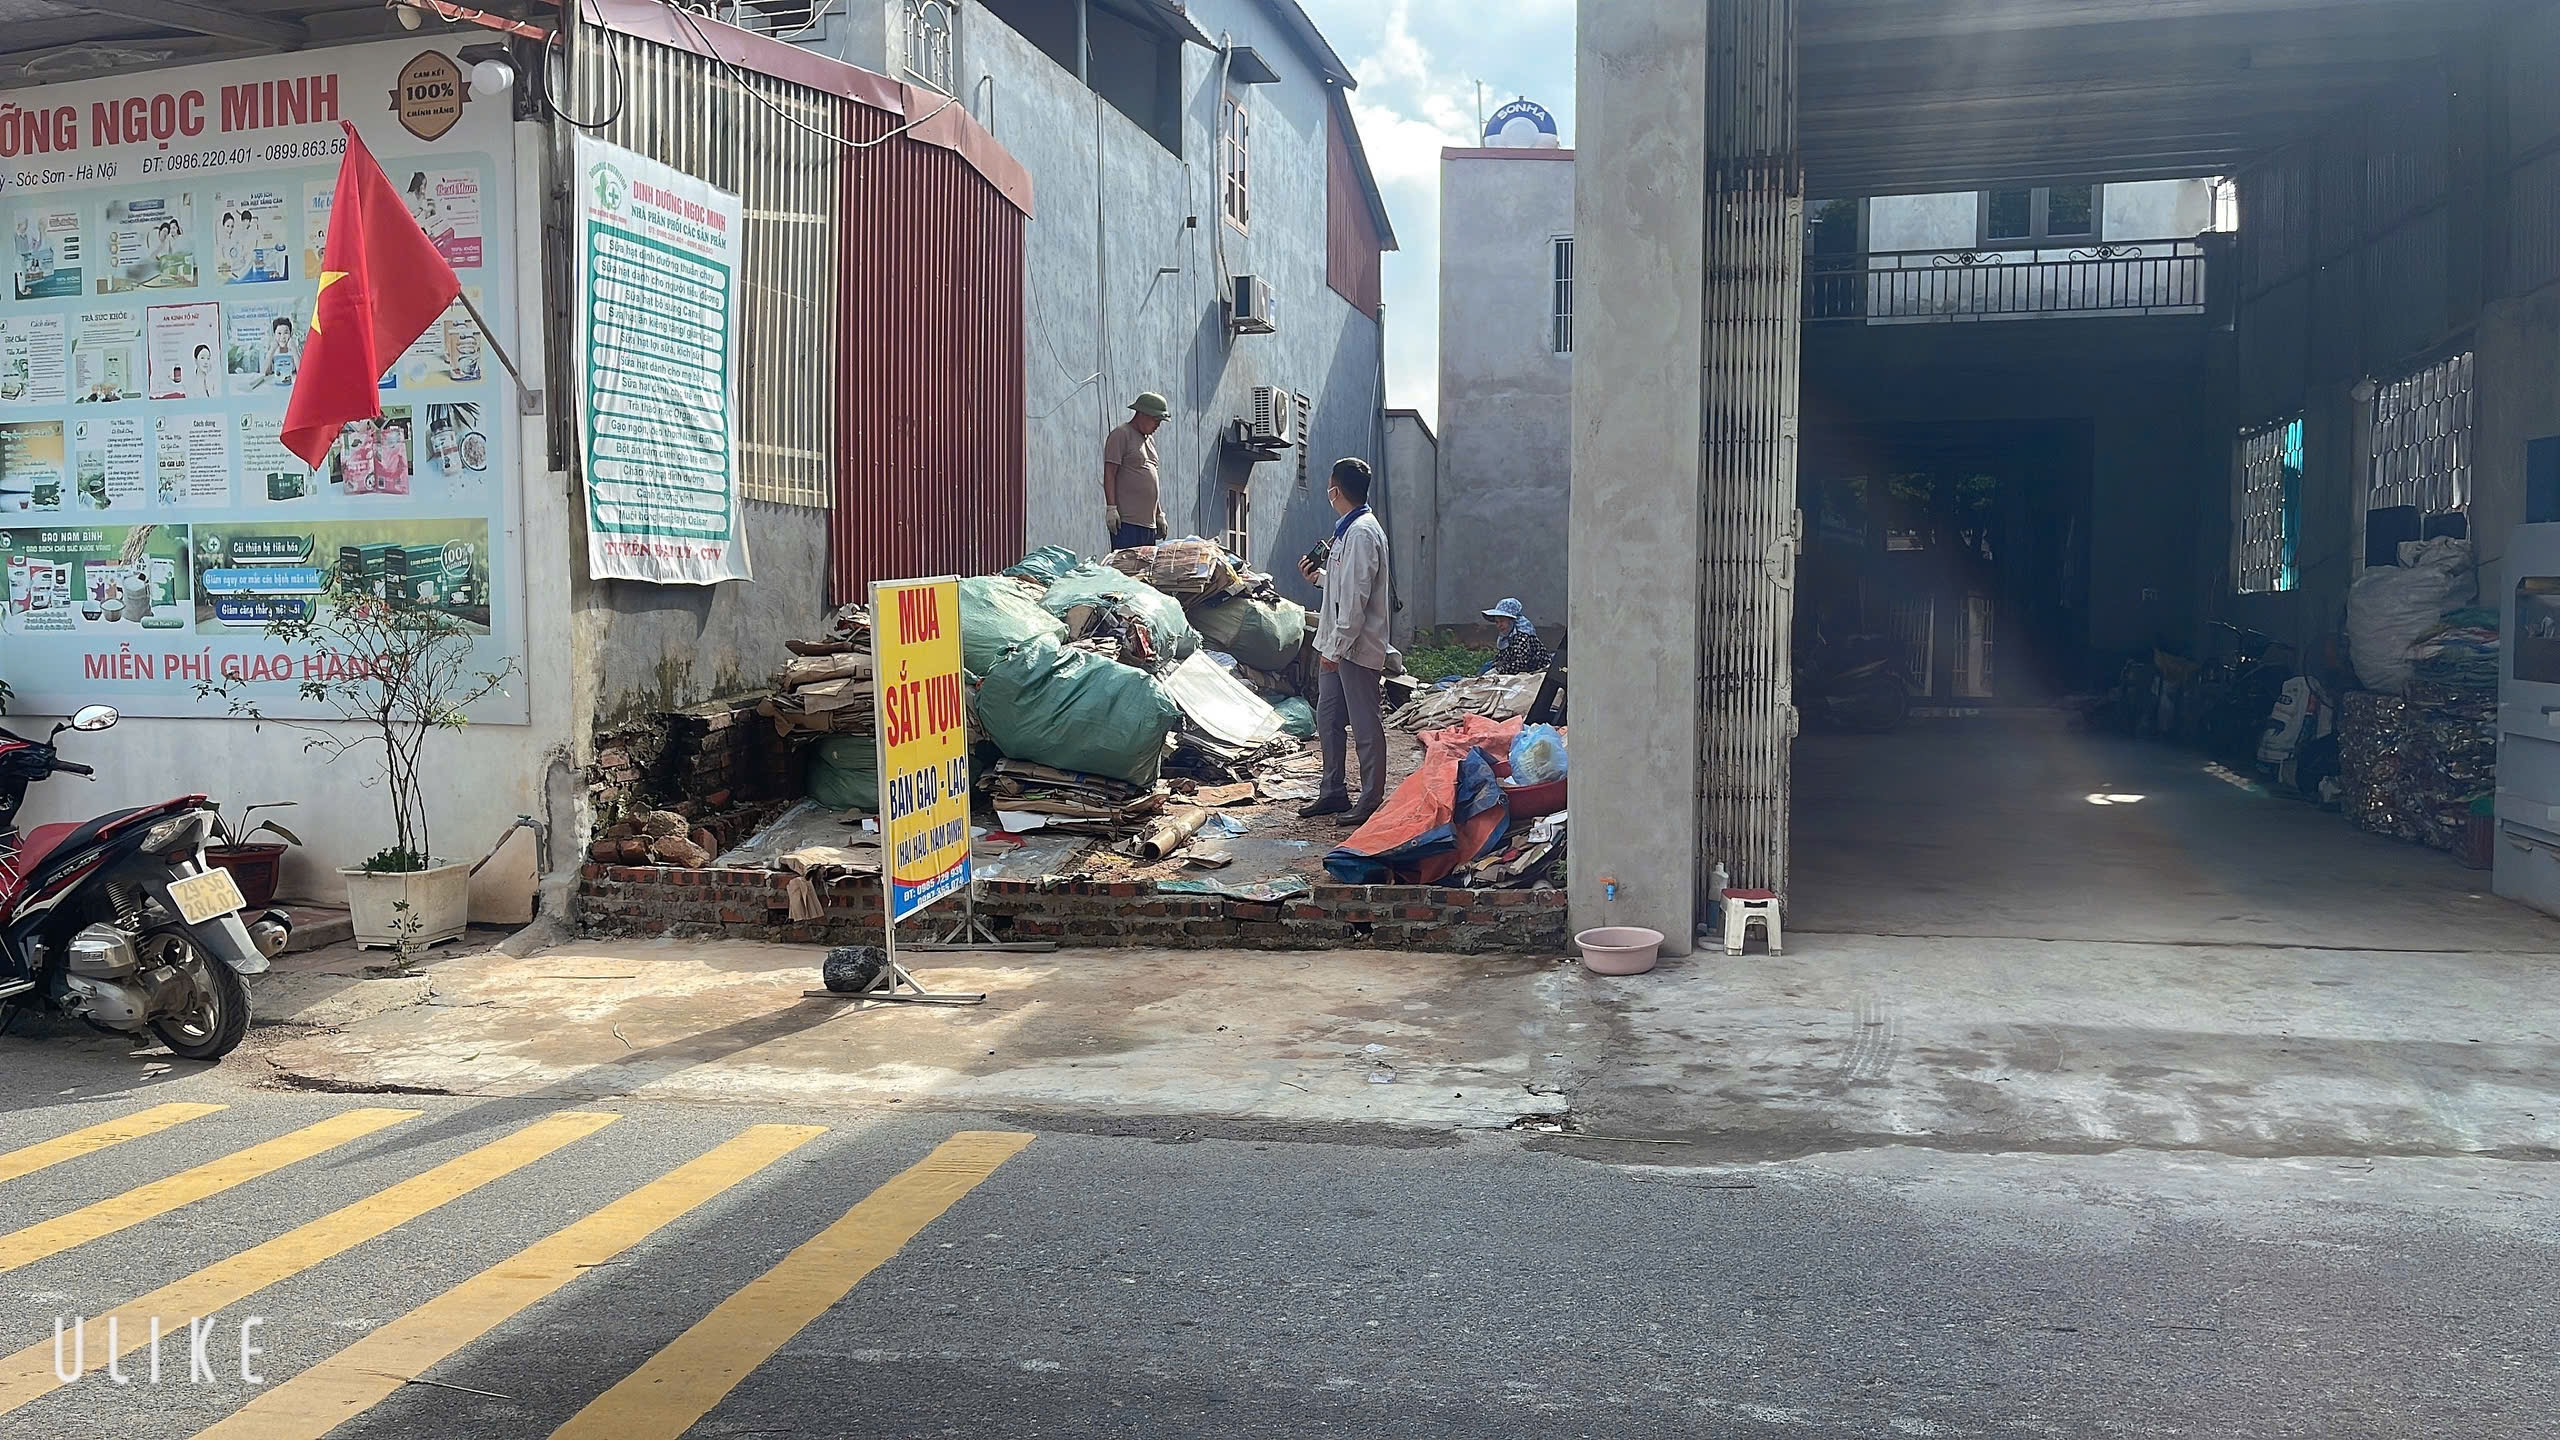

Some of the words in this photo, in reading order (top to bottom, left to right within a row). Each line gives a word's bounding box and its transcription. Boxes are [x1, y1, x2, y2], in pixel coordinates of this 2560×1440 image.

[406, 82, 454, 100] 100%
[92, 90, 204, 150] NGỌC
[221, 74, 338, 132] MINH
[1497, 103, 1546, 121] SONHA
[143, 157, 164, 173] ĐT:
[167, 148, 252, 171] 0986.220.401
[265, 138, 347, 161] 0899.863.58
[16, 171, 38, 187] Sóc
[42, 169, 65, 184] Sơn
[77, 165, 93, 181] Hà
[97, 162, 117, 180] Nội
[633, 180, 654, 204] DINH
[656, 188, 682, 215] DƯỠNG
[684, 200, 705, 226] NGỌC
[707, 209, 726, 232] MINH
[631, 204, 646, 220] NHÀ
[667, 217, 682, 233] PHỐI
[683, 223, 696, 238] CÁC
[697, 227, 709, 242] SẢN
[710, 231, 727, 249] PHẨM
[609, 239, 624, 251] Sữa
[626, 244, 638, 259] hạt
[640, 249, 655, 262] dinh
[656, 255, 679, 272] dưỡng
[700, 269, 714, 284] chay
[601, 261, 617, 274] Sữa
[618, 266, 630, 279] hạt
[632, 269, 649, 283] dành
[651, 275, 664, 288] cho
[665, 281, 685, 295] người
[687, 285, 699, 298] tiểu
[700, 290, 720, 307] đường
[625, 289, 640, 302] Sữa
[641, 293, 654, 307] hạt
[655, 297, 664, 309] bổ
[665, 304, 682, 317] sung
[649, 316, 668, 332] kiêng
[620, 332, 636, 343] Sữa
[637, 334, 649, 347] hạt
[620, 356, 635, 367] Sữa
[636, 358, 648, 371] hạt
[650, 362, 666, 374] dành
[668, 366, 680, 377] cho
[681, 371, 692, 381] mẹ
[621, 376, 637, 388] Sữa
[639, 378, 650, 391] hạt
[694, 393, 704, 402] em
[627, 399, 639, 410] Trà
[611, 419, 626, 433] Gạo
[616, 442, 630, 455] Bột
[631, 444, 640, 454] ăn
[699, 457, 709, 466] em
[683, 473, 705, 486] dưỡng
[680, 493, 694, 504] sinh
[61, 532, 80, 542] NAM
[83, 528, 103, 541] BÌNH
[234, 541, 244, 552] Cải
[245, 541, 261, 555] thiện
[263, 541, 271, 554] hệ
[273, 541, 285, 552] tiêu
[287, 541, 298, 552] hóa
[605, 536, 651, 557] TUYỂN
[701, 547, 722, 561] CTV
[222, 604, 237, 615] Giảm
[239, 604, 253, 617] căng
[898, 587, 940, 645] MUA
[84, 642, 154, 680] MIỄN
[163, 646, 212, 680] PHÍ
[221, 653, 293, 681] GIAO
[886, 660, 921, 747] SẮT
[925, 672, 962, 745] VỤN
[889, 768, 914, 821] BÁN
[916, 765, 938, 816] GẠO
[946, 755, 966, 804] LẠC
[930, 824, 946, 852] NAM
[178, 875, 224, 901] 29-S6
[184, 889, 241, 921] 284.02
